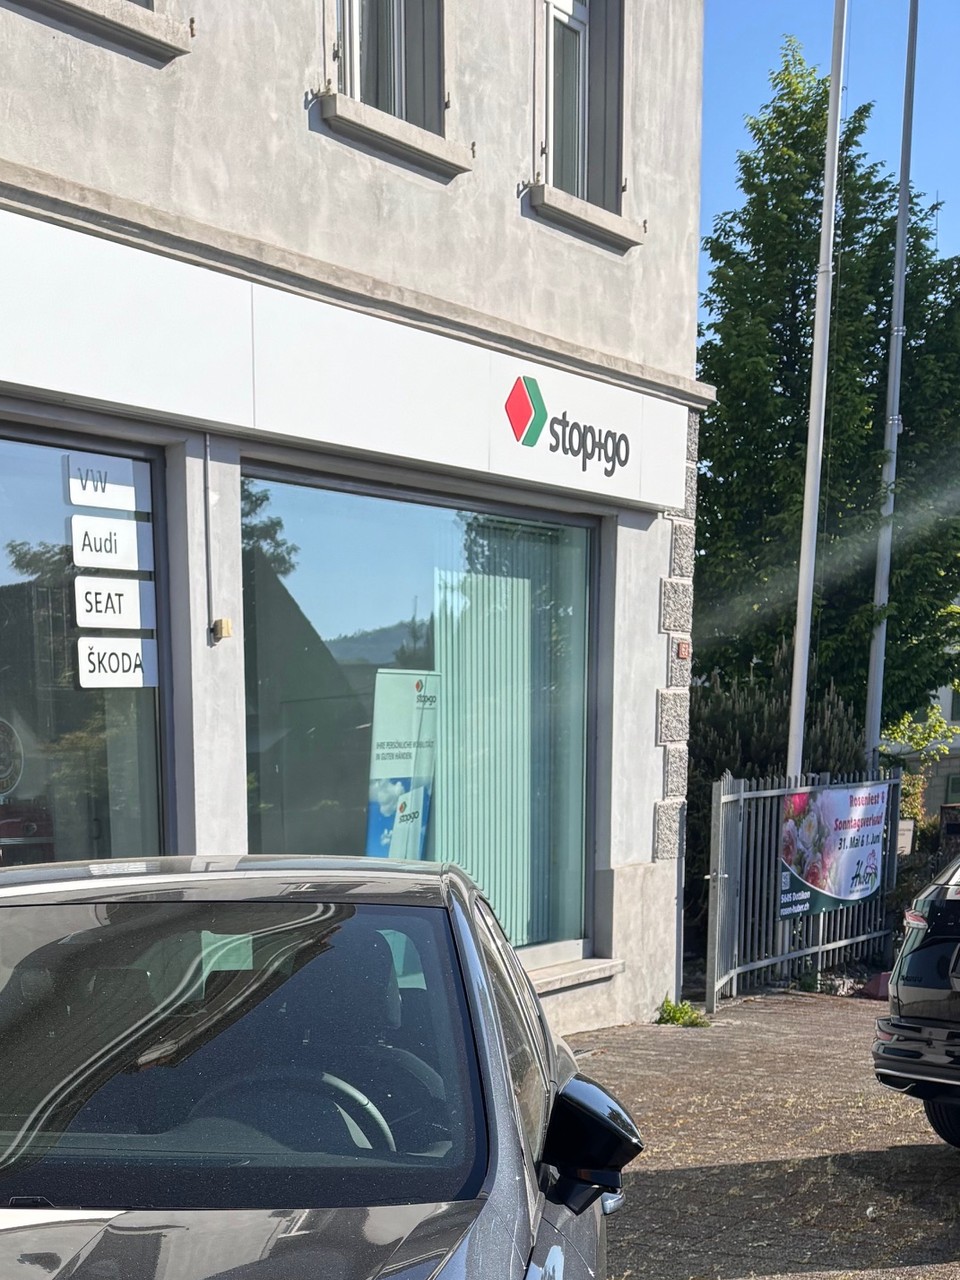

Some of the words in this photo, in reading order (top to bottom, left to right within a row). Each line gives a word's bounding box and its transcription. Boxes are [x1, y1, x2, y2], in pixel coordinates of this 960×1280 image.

[549, 411, 630, 477] stop+go
[78, 467, 108, 493] VW
[81, 531, 118, 554] Audi
[84, 591, 124, 614] SEAT
[87, 646, 145, 674] ŠKODA
[834, 812, 883, 832] Sonntagsverkauf
